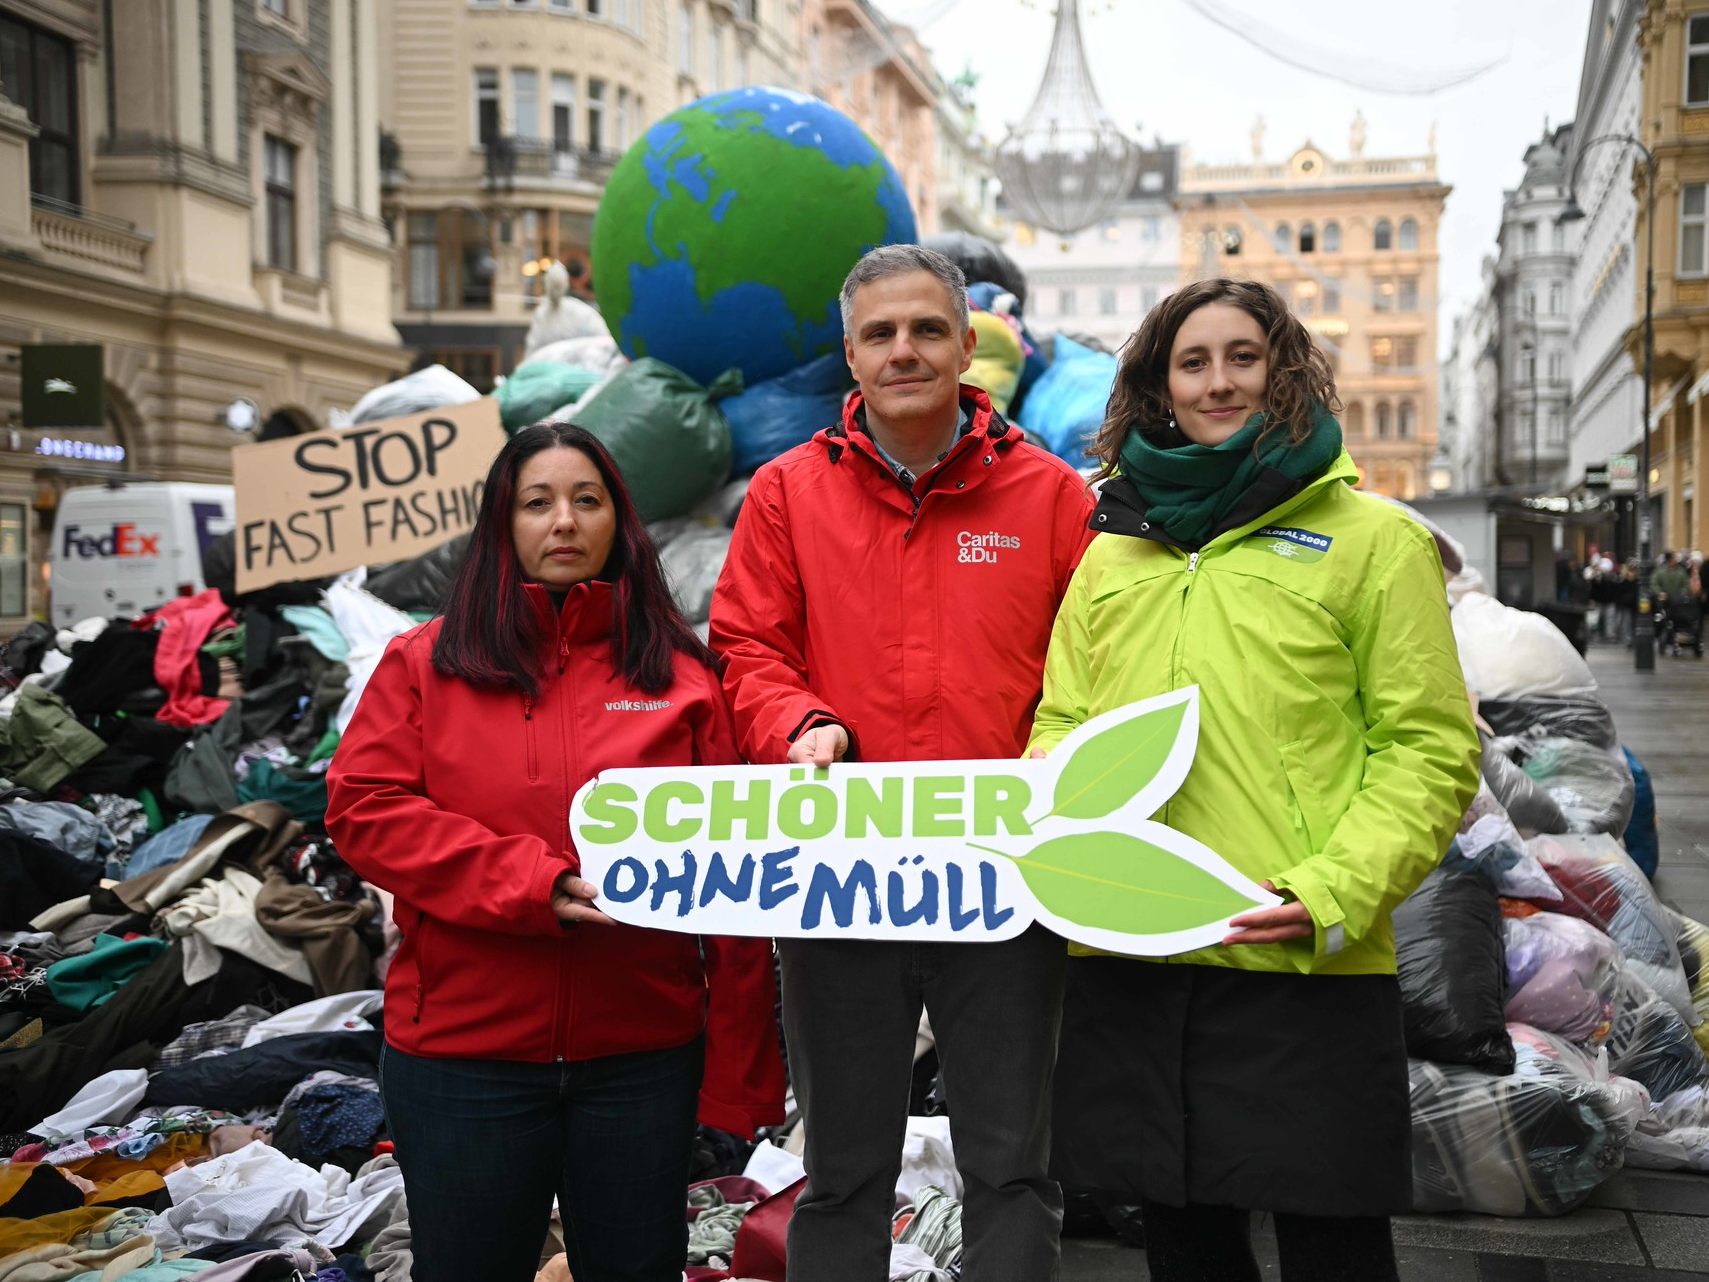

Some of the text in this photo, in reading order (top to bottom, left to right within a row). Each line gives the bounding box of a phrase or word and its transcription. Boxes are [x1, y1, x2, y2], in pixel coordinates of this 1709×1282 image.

[294, 418, 458, 499] STOP
[63, 522, 159, 559] FedEx
[243, 504, 345, 570] FAST
[363, 480, 485, 547] FASHIO
[957, 531, 1021, 549] Caritas
[1260, 528, 1328, 547] GLOBAL 2000
[957, 547, 997, 563] &Du
[579, 768, 1033, 845] SCHÖNER
[603, 846, 1014, 931] OHNE MÜLL
